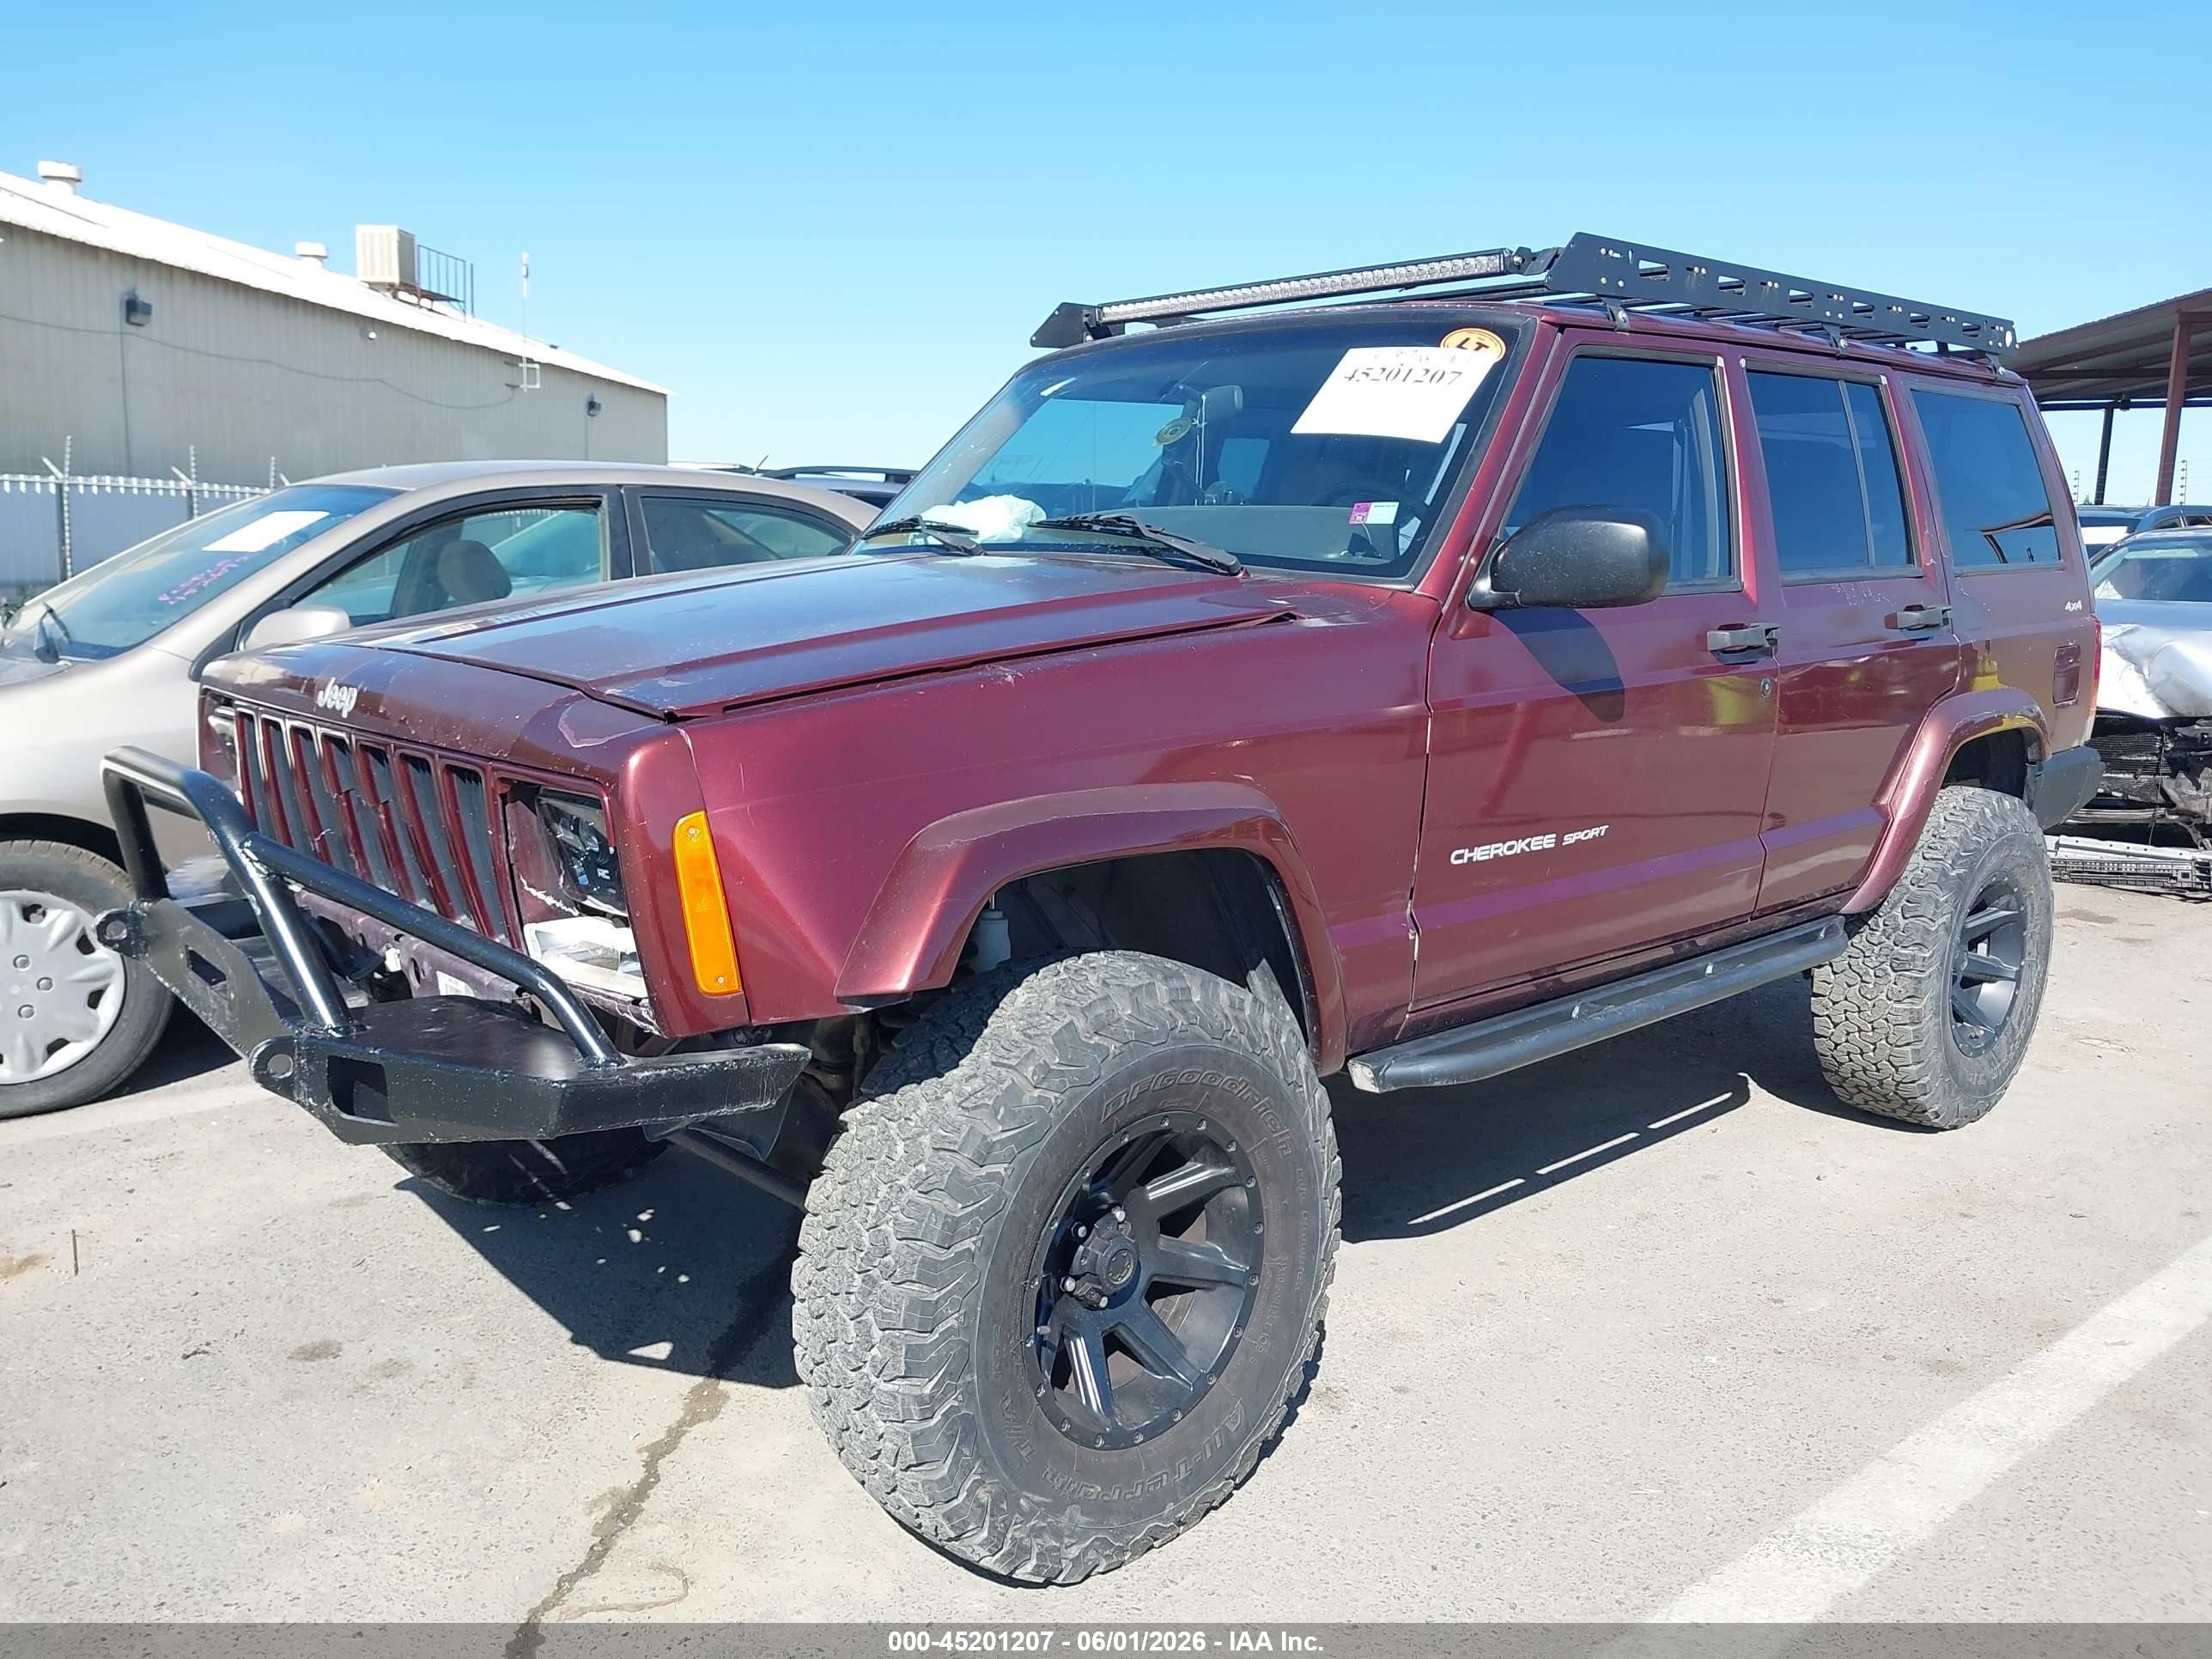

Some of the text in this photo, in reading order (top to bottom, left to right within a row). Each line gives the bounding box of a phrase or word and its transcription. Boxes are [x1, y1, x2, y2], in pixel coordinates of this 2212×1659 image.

[1344, 367, 1463, 386] 45201207
[317, 677, 358, 719] Jeep
[1449, 824, 1610, 866] CHEROKEE SPORT
[1101, 1068, 1292, 1159] BFGoodrich
